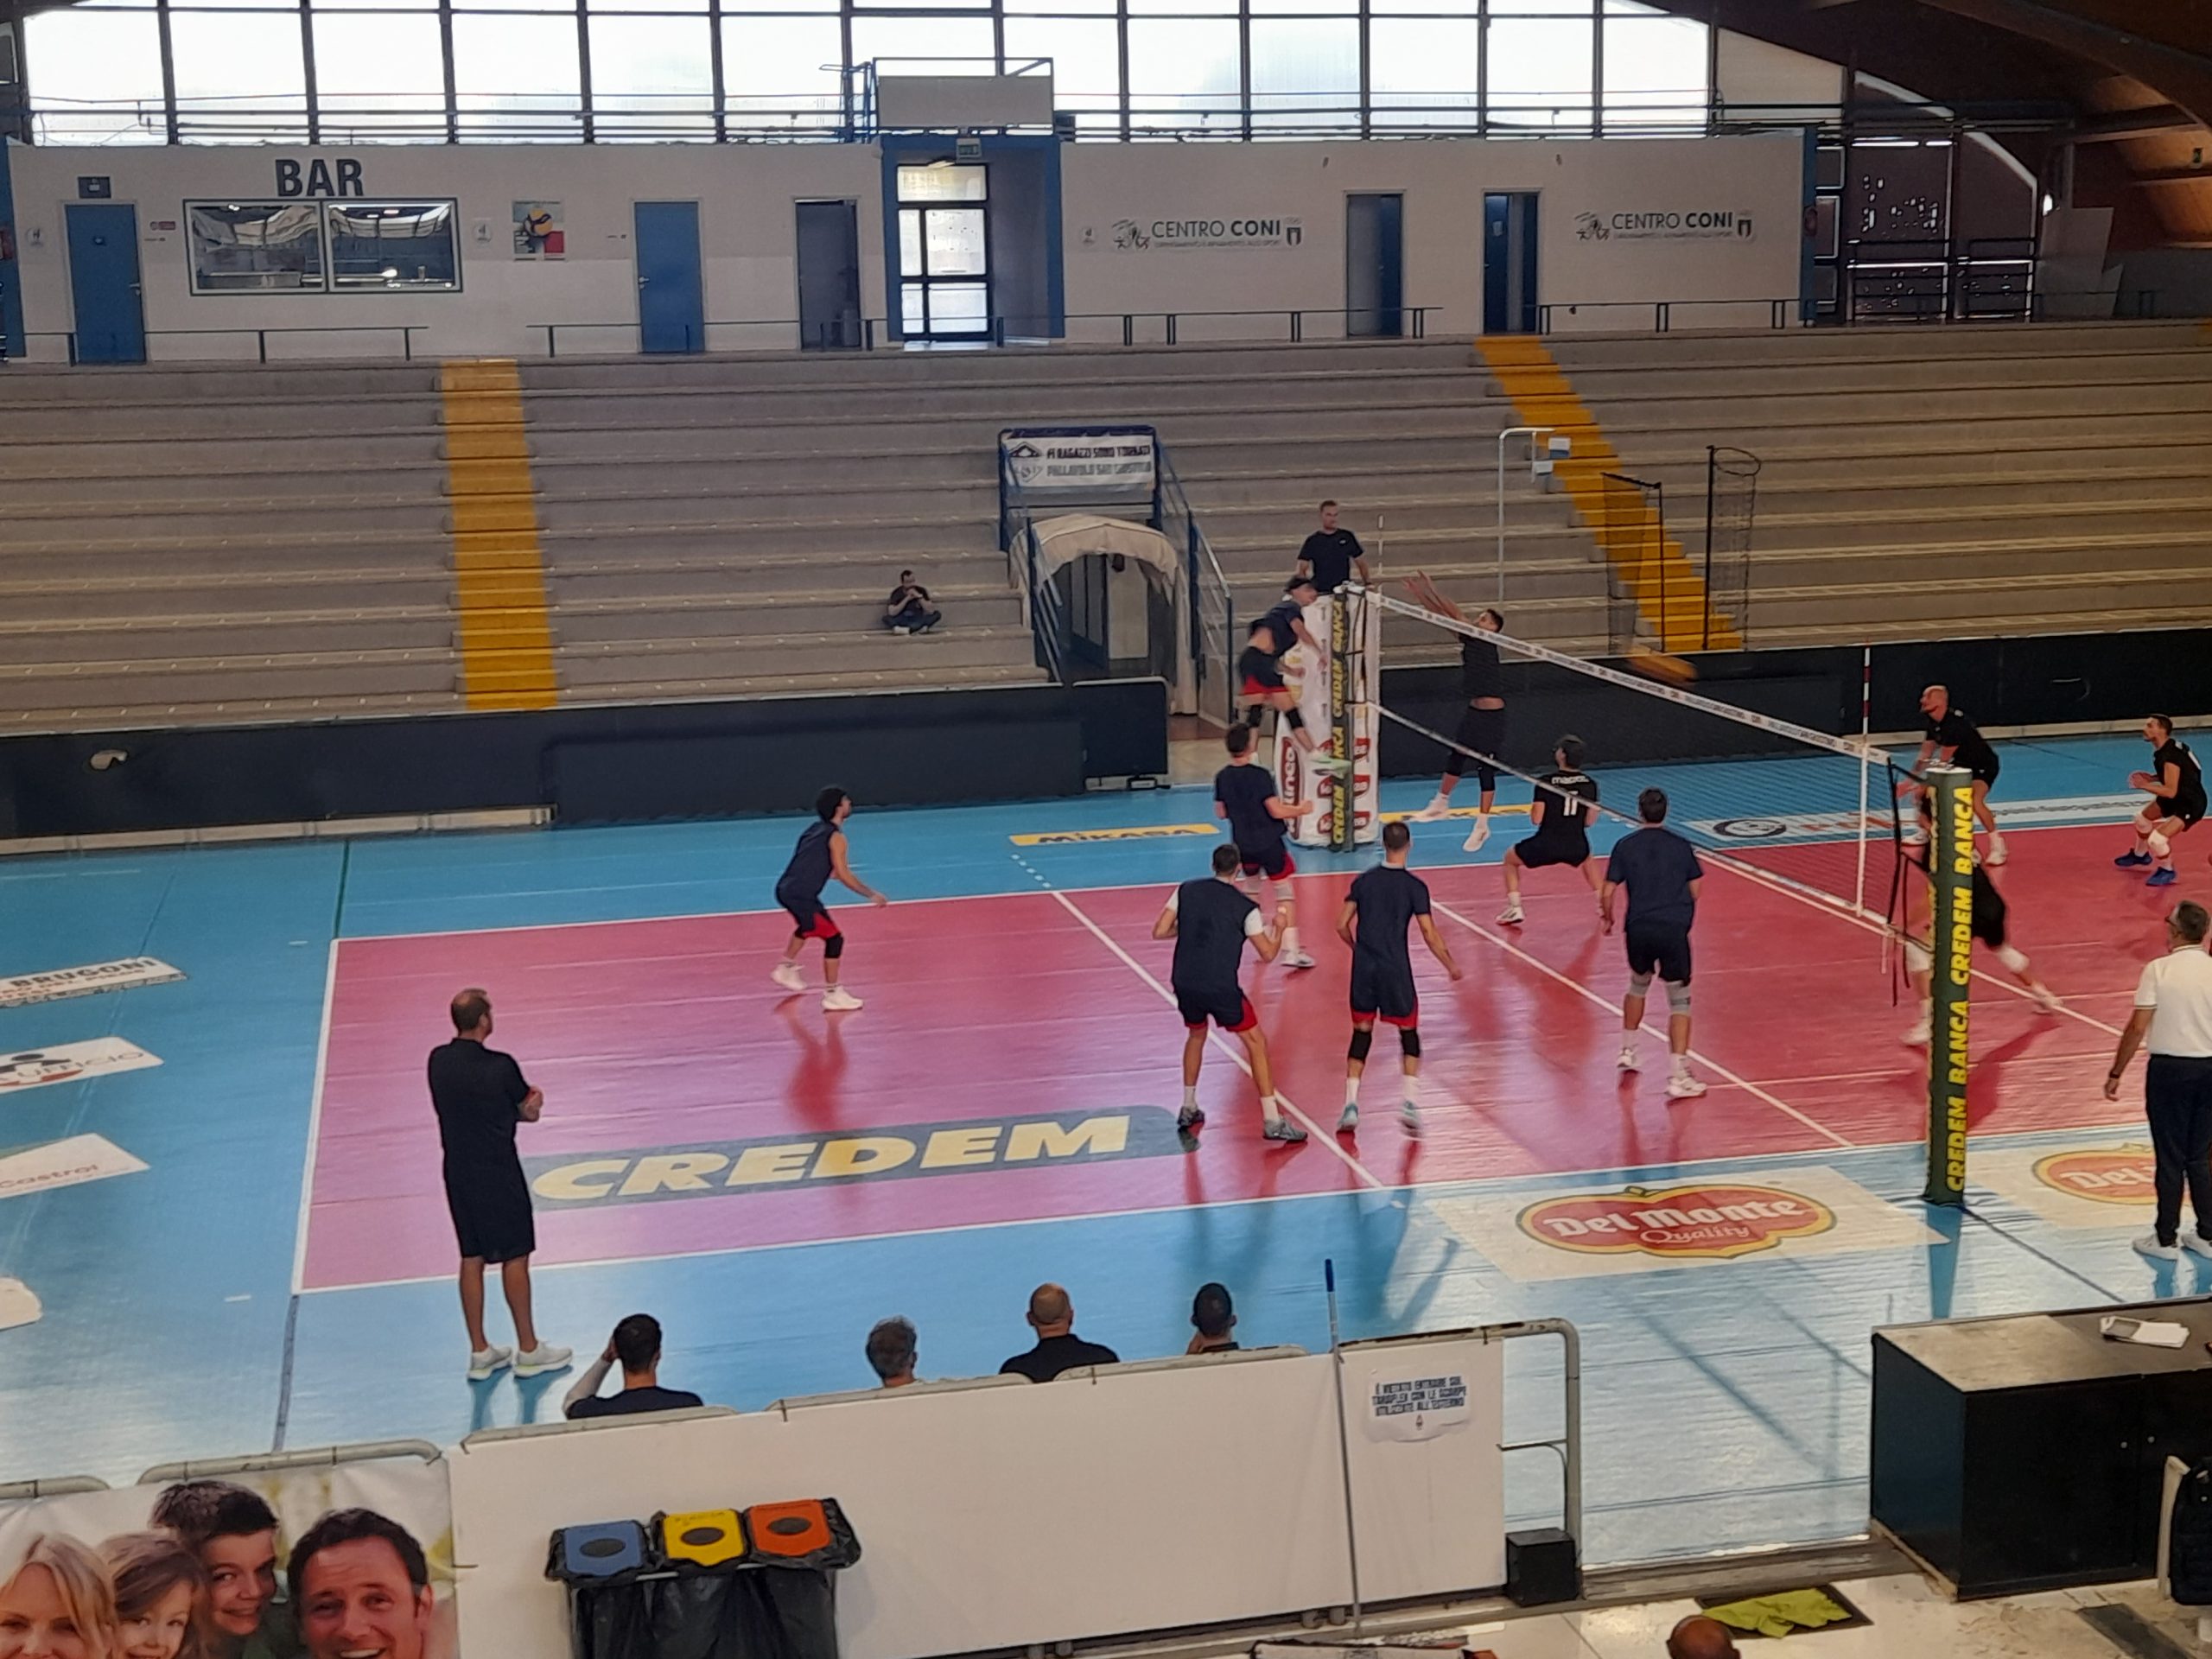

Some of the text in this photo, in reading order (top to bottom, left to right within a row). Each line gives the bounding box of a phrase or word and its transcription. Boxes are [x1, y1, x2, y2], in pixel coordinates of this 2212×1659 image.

[275, 159, 364, 196] BAR
[1152, 219, 1281, 238] CENTRO CONI
[1611, 212, 1733, 230] CENTRO CONI
[1332, 784, 1344, 843] CREDEM
[10, 959, 156, 987] BRUGONI
[1946, 786, 1974, 1192] CREDEM BANCA CREDEM BANCA
[17, 1052, 143, 1077] UFFICIO
[532, 1115, 1131, 1200] CREDEM
[1542, 1199, 1814, 1237] Del Monte
[1640, 1224, 1749, 1243] Quality
